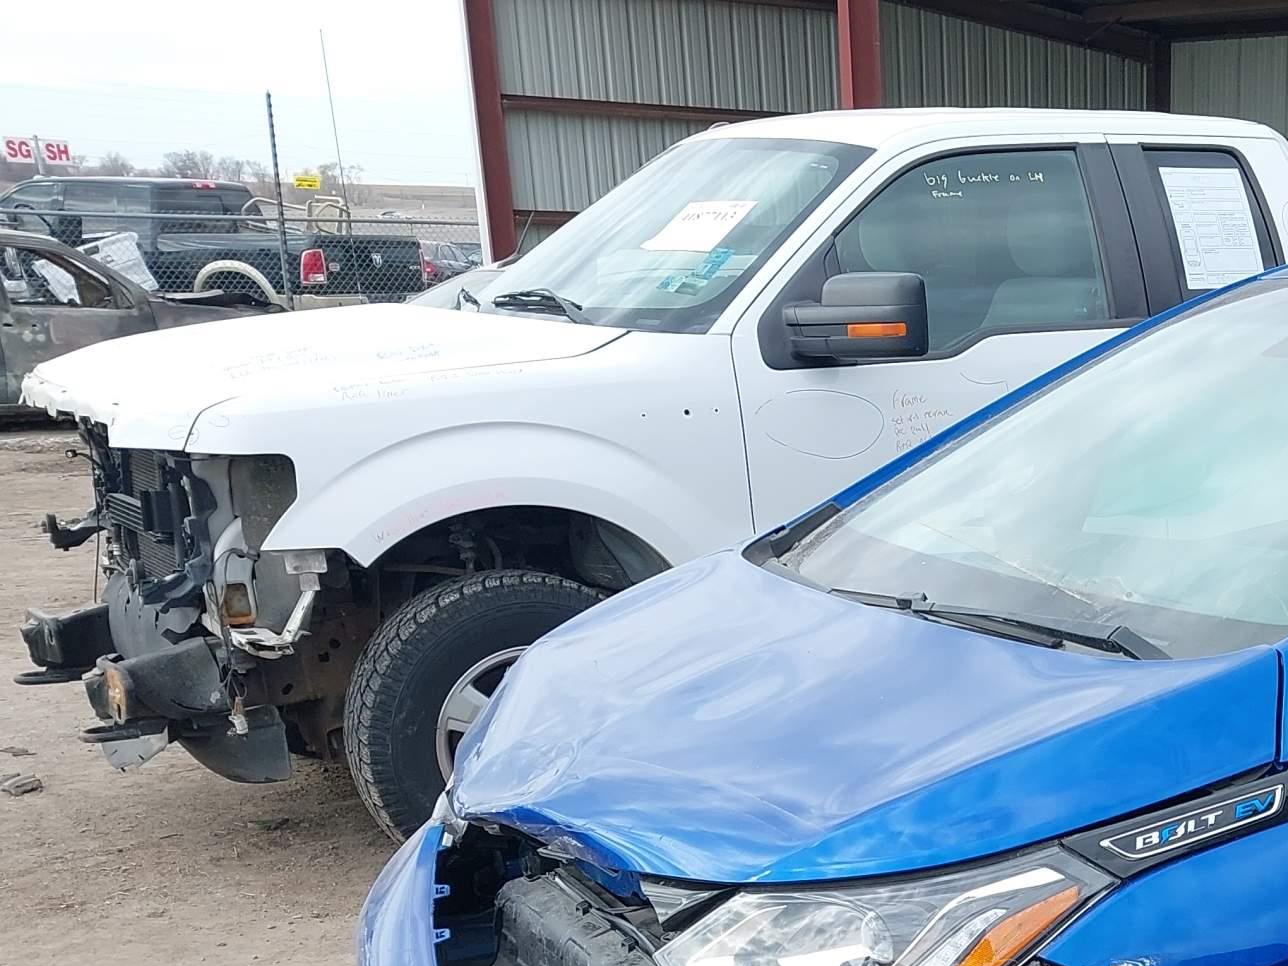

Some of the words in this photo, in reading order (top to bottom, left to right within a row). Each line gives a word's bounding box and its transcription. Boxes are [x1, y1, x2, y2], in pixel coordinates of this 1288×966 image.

[6, 139, 33, 159] SG
[45, 143, 71, 161] SH
[923, 171, 948, 188] big
[1135, 810, 1224, 851] BOLT
[1233, 793, 1273, 819] EV
